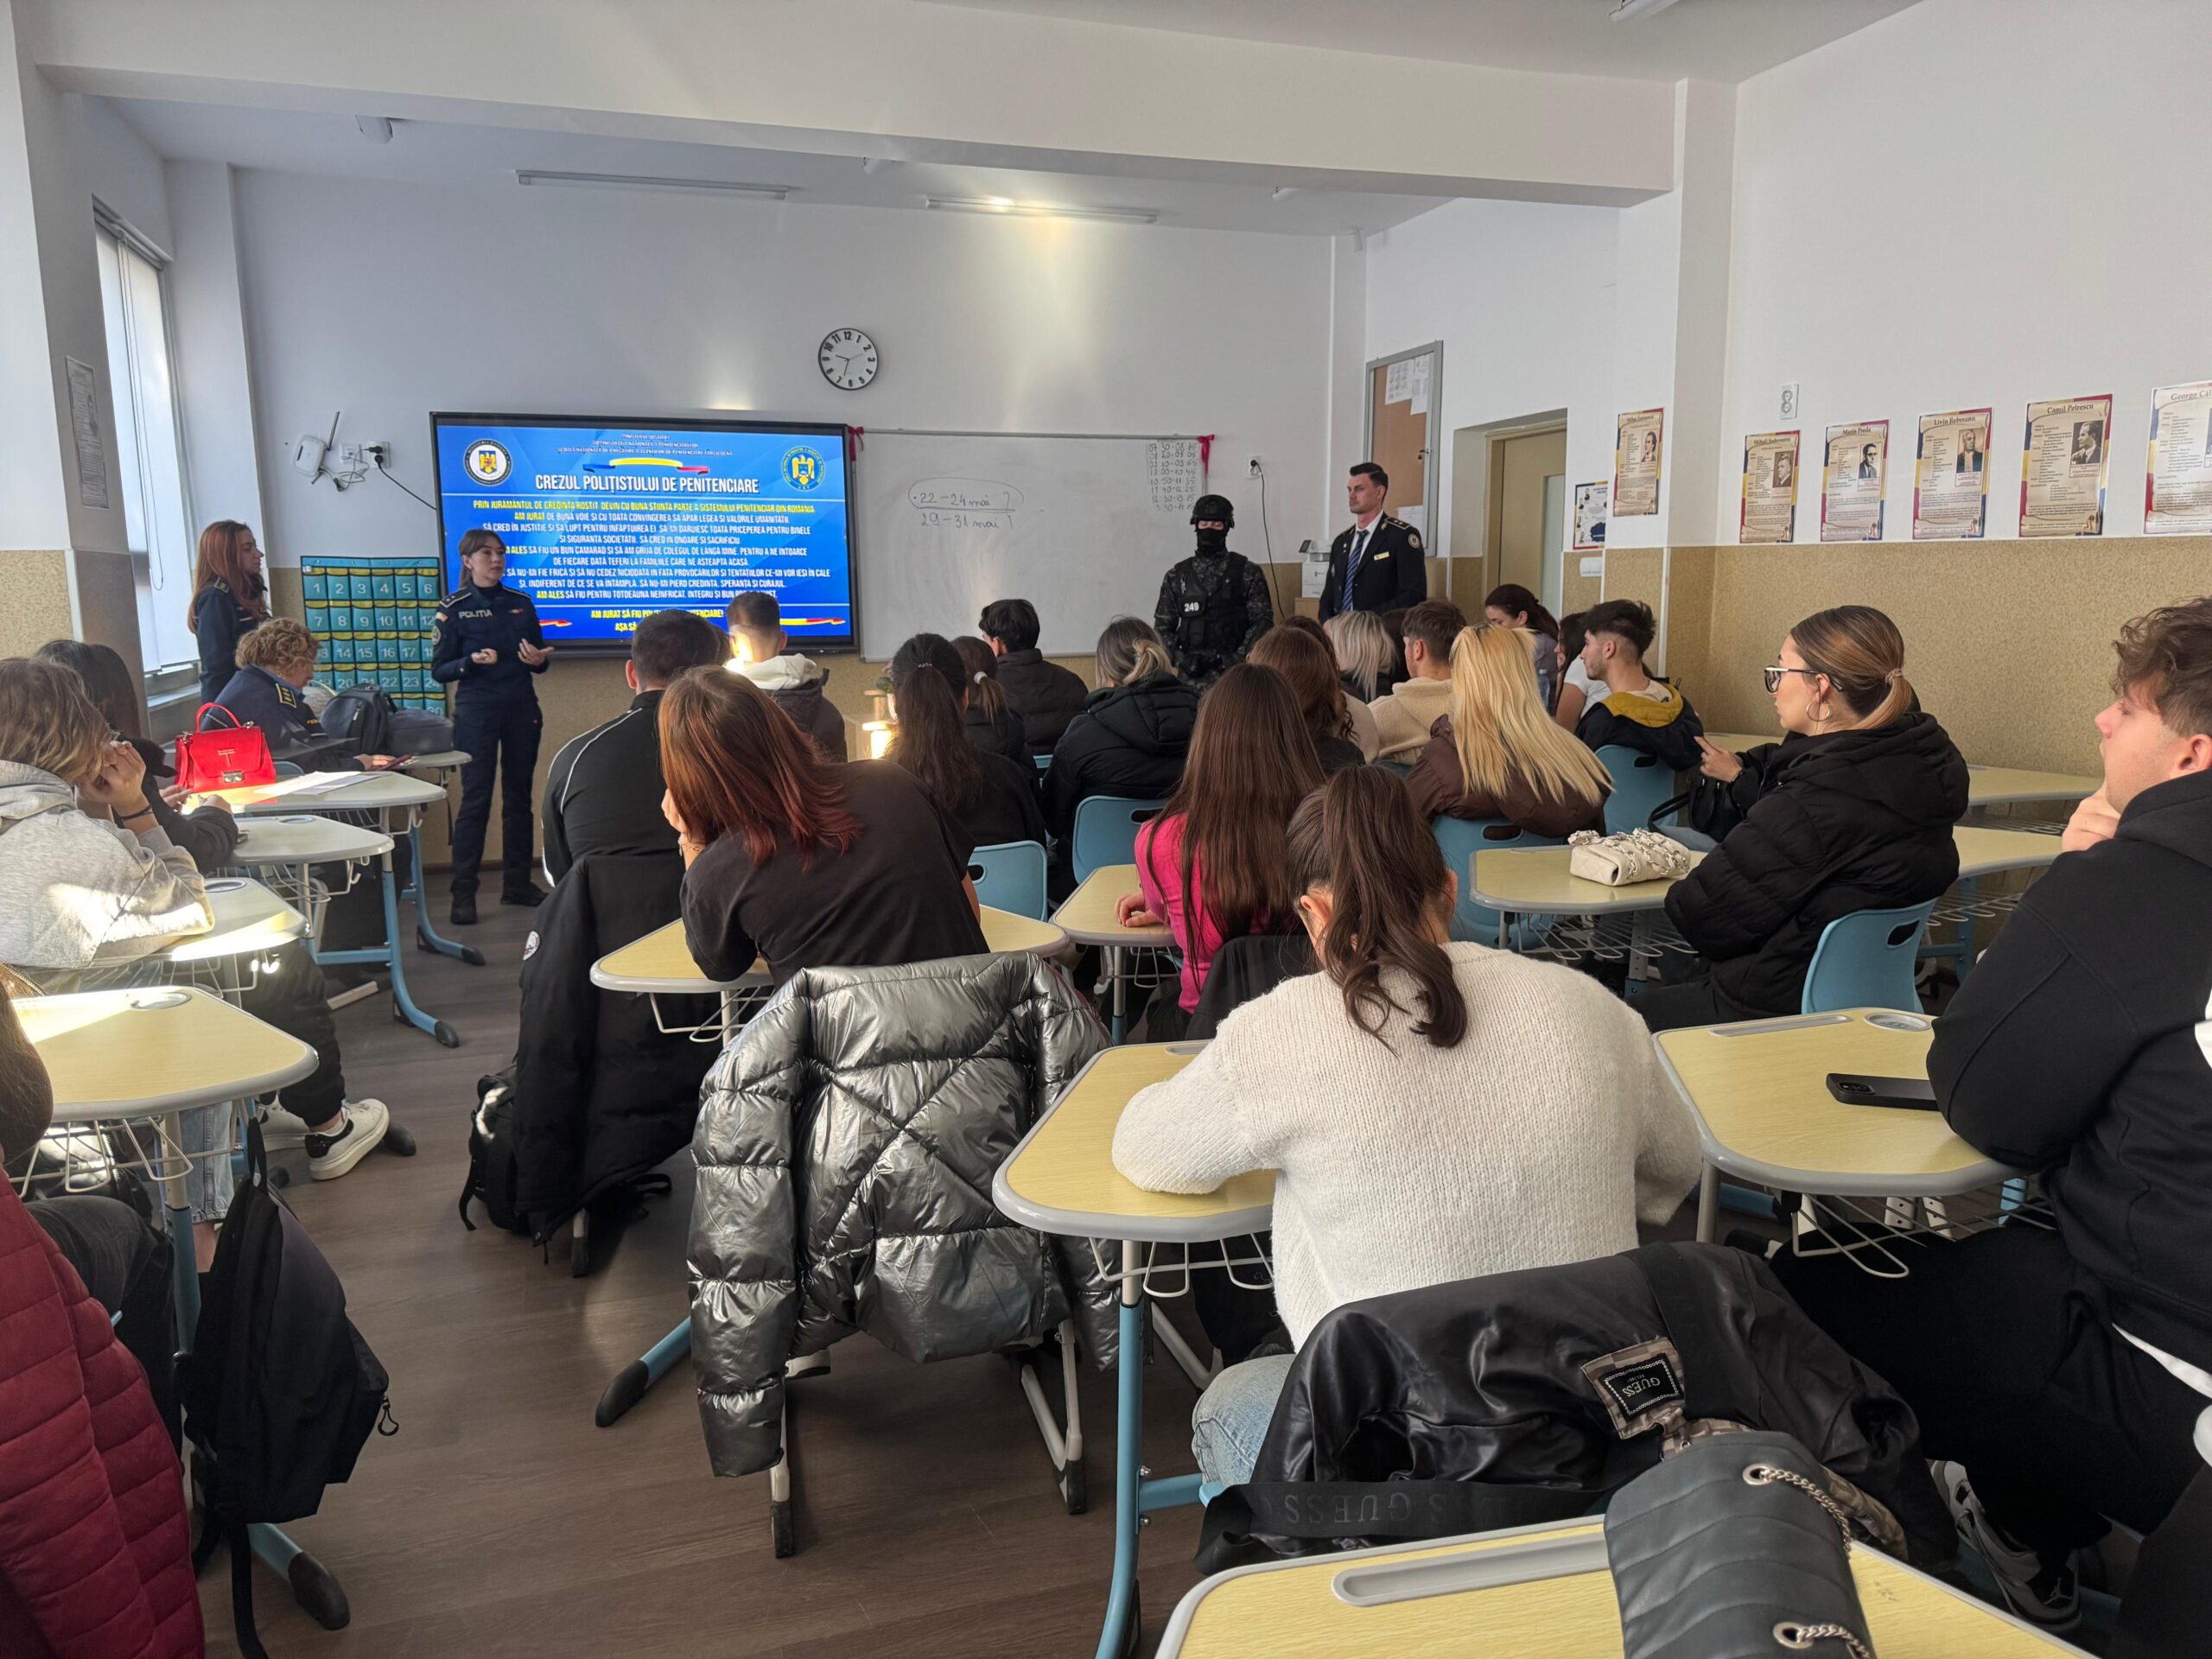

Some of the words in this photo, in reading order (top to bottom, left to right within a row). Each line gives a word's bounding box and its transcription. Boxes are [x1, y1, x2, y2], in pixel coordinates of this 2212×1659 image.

[831, 334, 841, 343] 11
[843, 331, 852, 340] 12
[823, 342, 834, 352] 10
[536, 475, 581, 490] CREZUL
[663, 477, 677, 492] DE
[680, 478, 759, 493] PENITENCIARE
[969, 494, 990, 506] mai
[972, 518, 999, 529] mai
[314, 584, 320, 594] 1
[335, 584, 344, 594] 2
[358, 583, 366, 594] 3
[380, 583, 389, 594] 4
[403, 583, 410, 593] 5
[424, 583, 432, 594] 6
[1184, 602, 1199, 612] 249
[315, 617, 322, 626] 7
[338, 616, 346, 626] 8
[359, 616, 369, 626] 9
[378, 616, 393, 626] 10
[401, 616, 413, 626] 11
[422, 616, 435, 626] 12
[337, 648, 351, 658] 14
[359, 648, 372, 658] 15
[380, 648, 395, 658] 16
[403, 648, 416, 658] 17
[338, 678, 353, 689] 20
[382, 677, 397, 687] 22
[404, 677, 419, 687] 23
[1623, 1377, 1661, 1397] GUESS
[1284, 1491, 1412, 1525] GUESS
